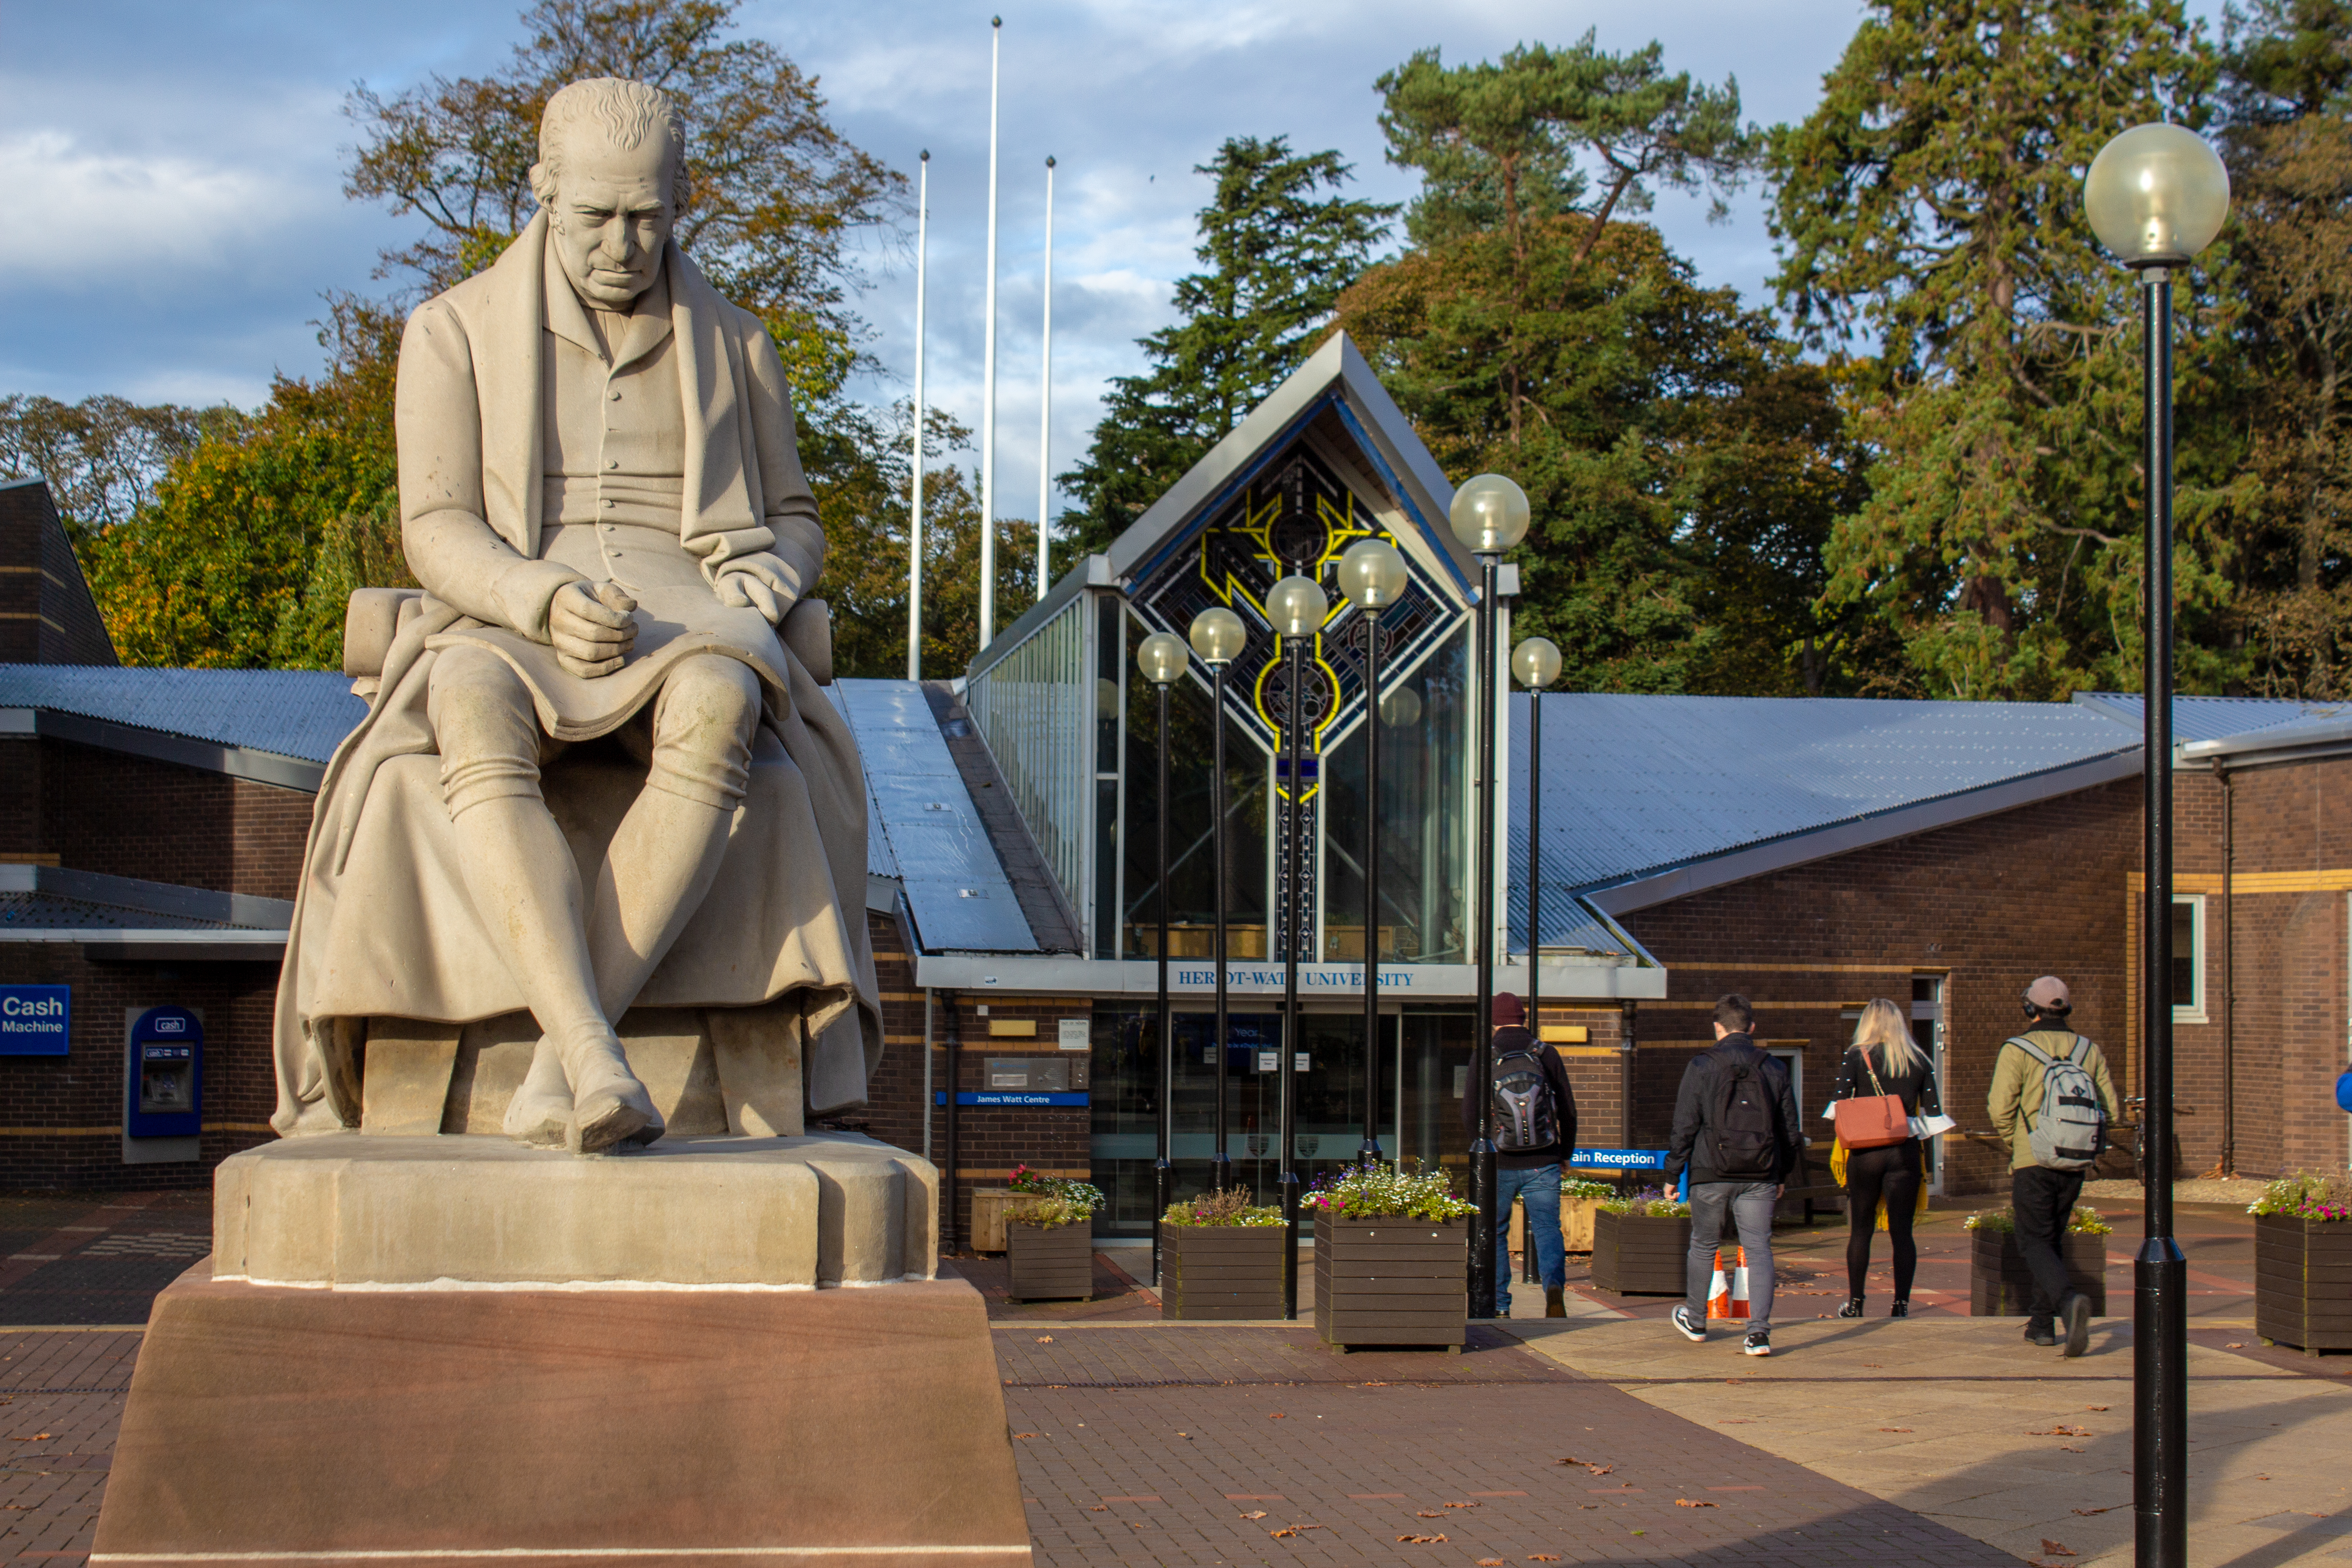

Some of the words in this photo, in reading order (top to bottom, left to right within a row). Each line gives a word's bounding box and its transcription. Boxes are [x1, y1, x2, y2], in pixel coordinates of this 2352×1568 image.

[1178, 971, 1299, 985] HEROT-WAT
[2, 996, 63, 1016] Cash
[2, 1020, 63, 1033] Machine
[1572, 1151, 1591, 1162] ain
[1594, 1152, 1655, 1166] Reception
